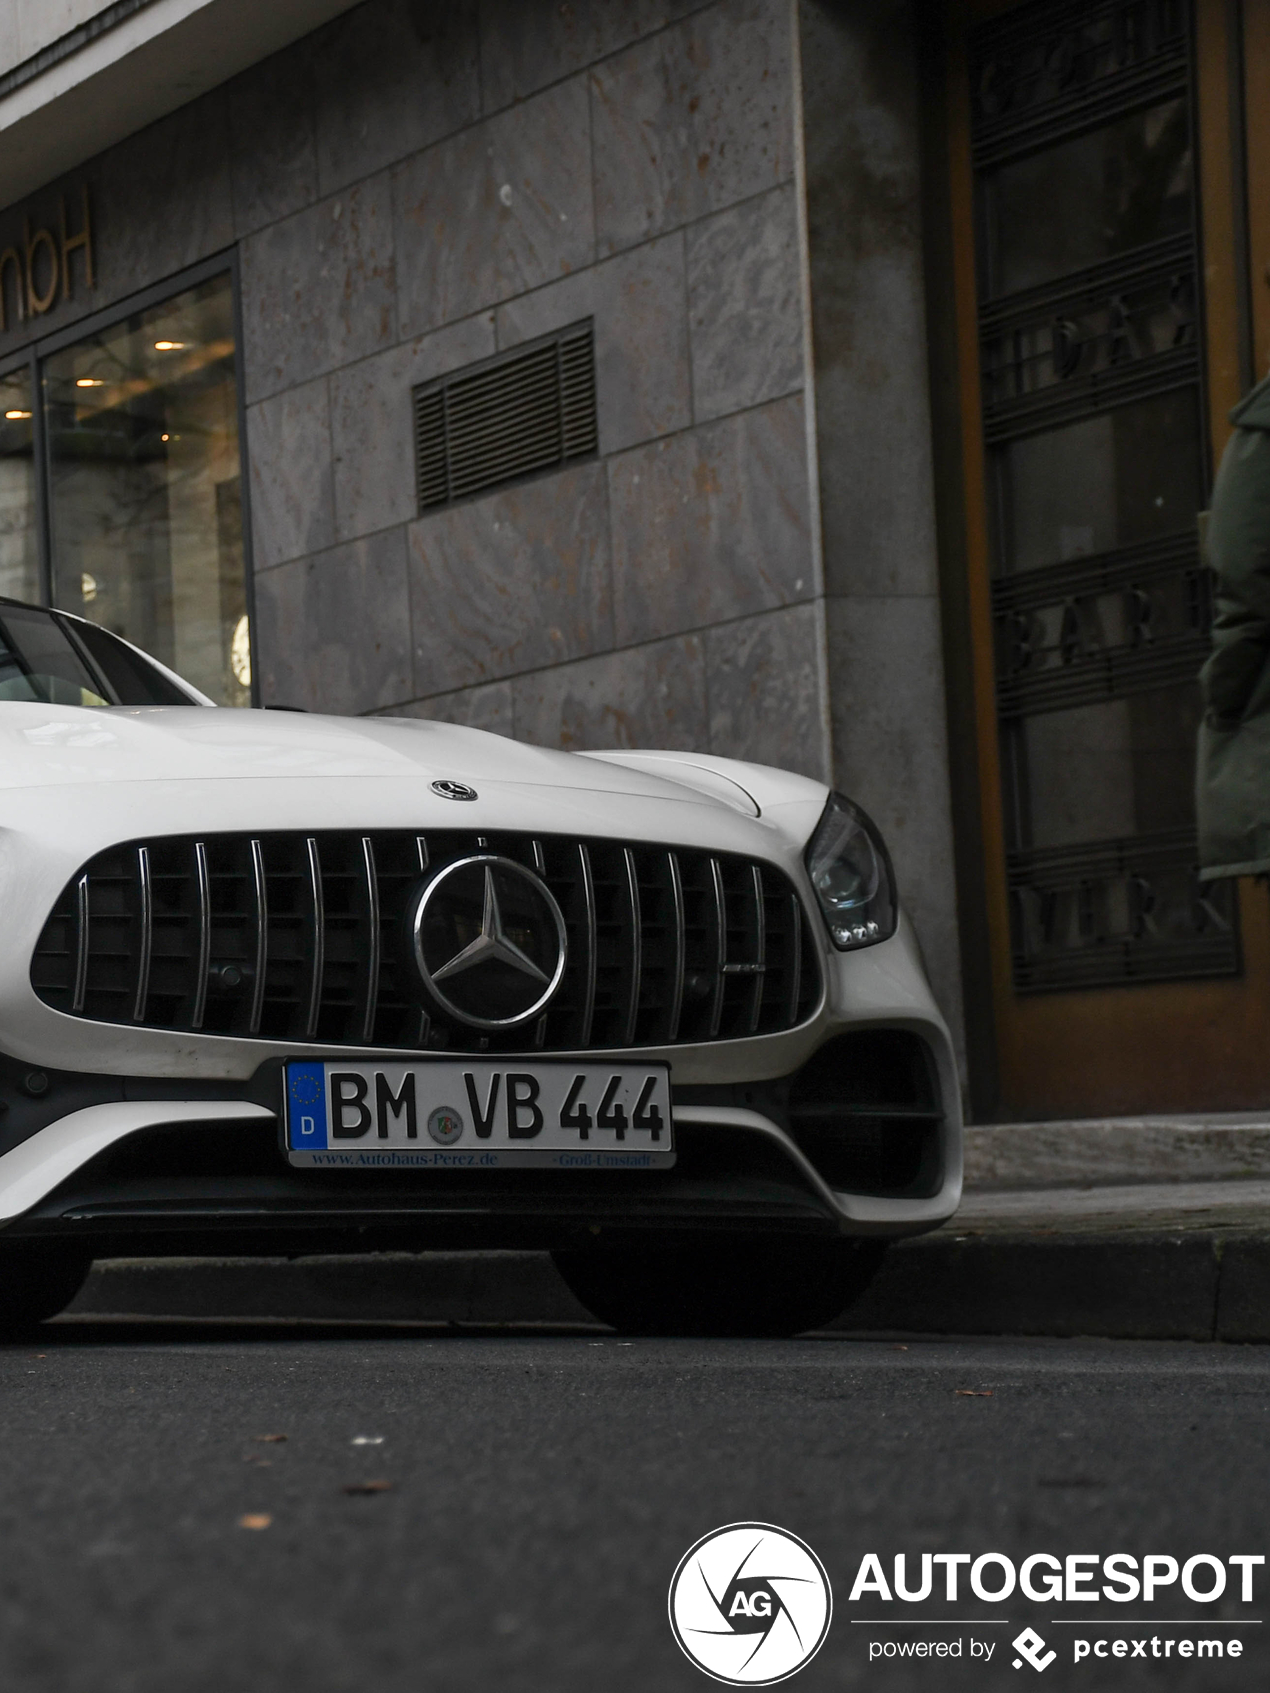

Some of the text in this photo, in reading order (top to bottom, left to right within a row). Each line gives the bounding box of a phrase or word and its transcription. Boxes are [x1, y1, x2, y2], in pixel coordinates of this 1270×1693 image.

[300, 1115, 315, 1135] D
[330, 1071, 418, 1139] BM
[463, 1072, 544, 1139] VB
[559, 1074, 663, 1141] 444
[312, 1152, 498, 1167] www.Autohaus-Perez.de
